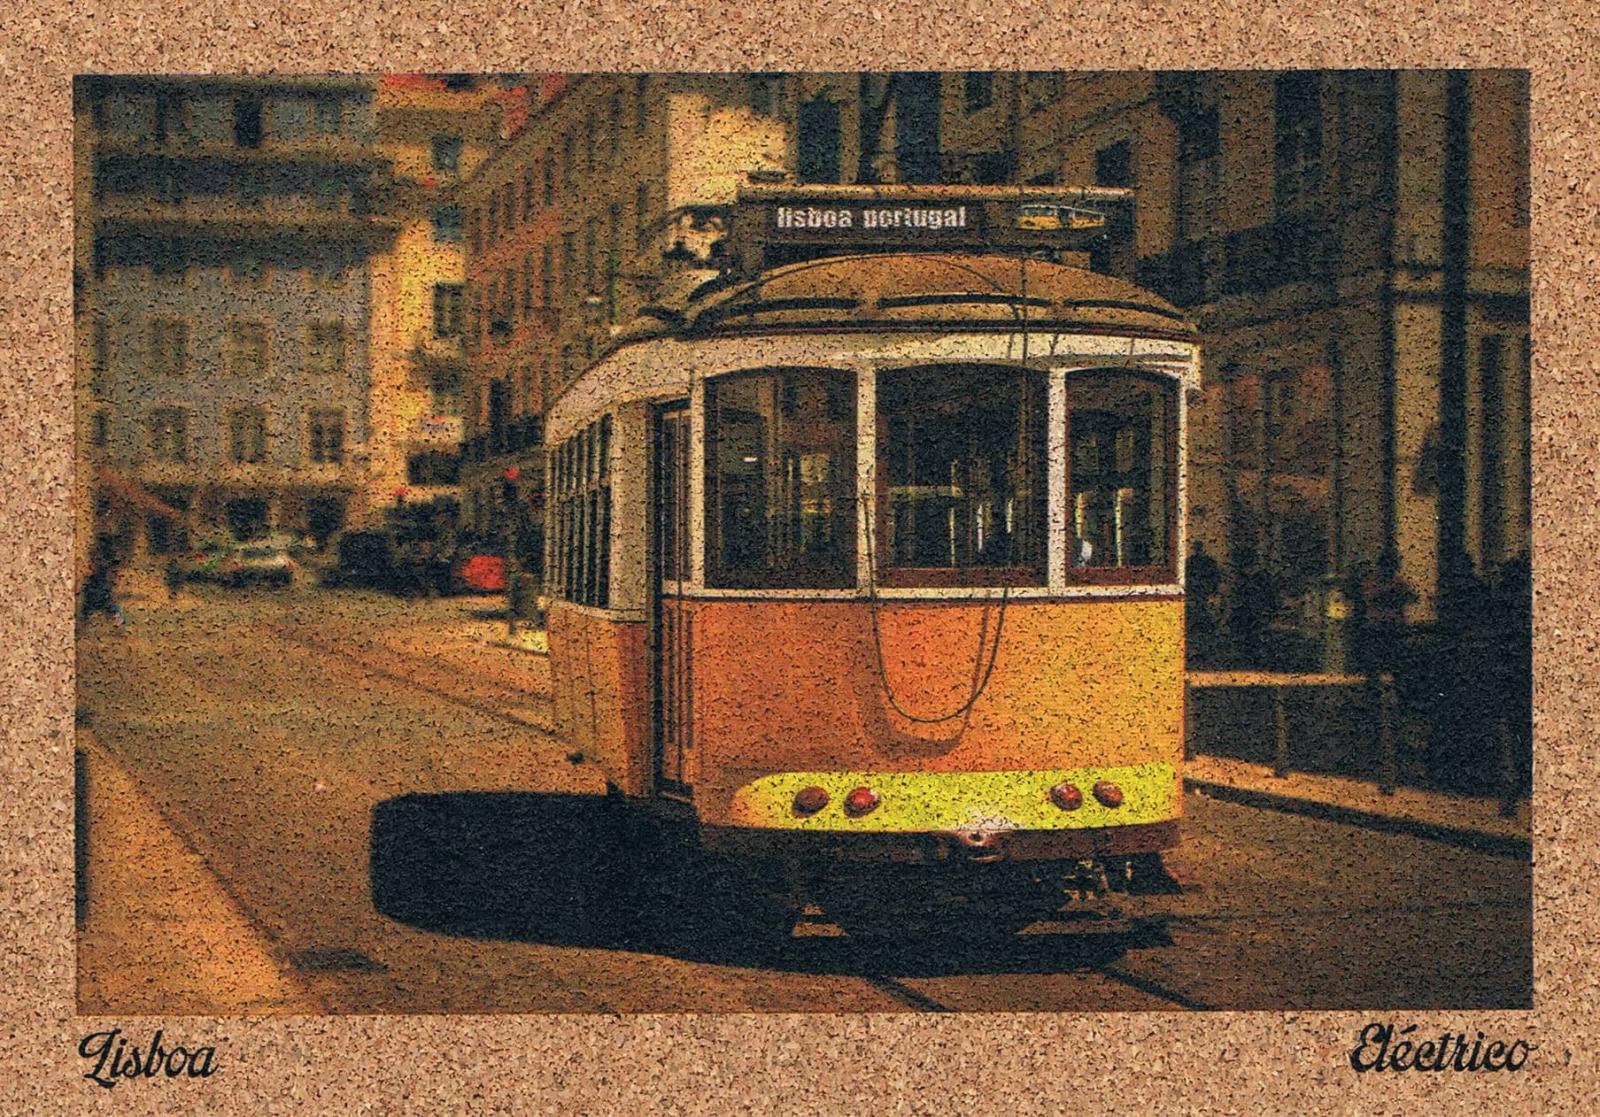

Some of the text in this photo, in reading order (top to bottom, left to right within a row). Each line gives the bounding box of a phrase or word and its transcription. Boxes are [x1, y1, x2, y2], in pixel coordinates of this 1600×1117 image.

[777, 206, 967, 231] lisboa portugal
[78, 1028, 220, 1088] Lisboa
[1349, 1023, 1539, 1073] Eléctrico
